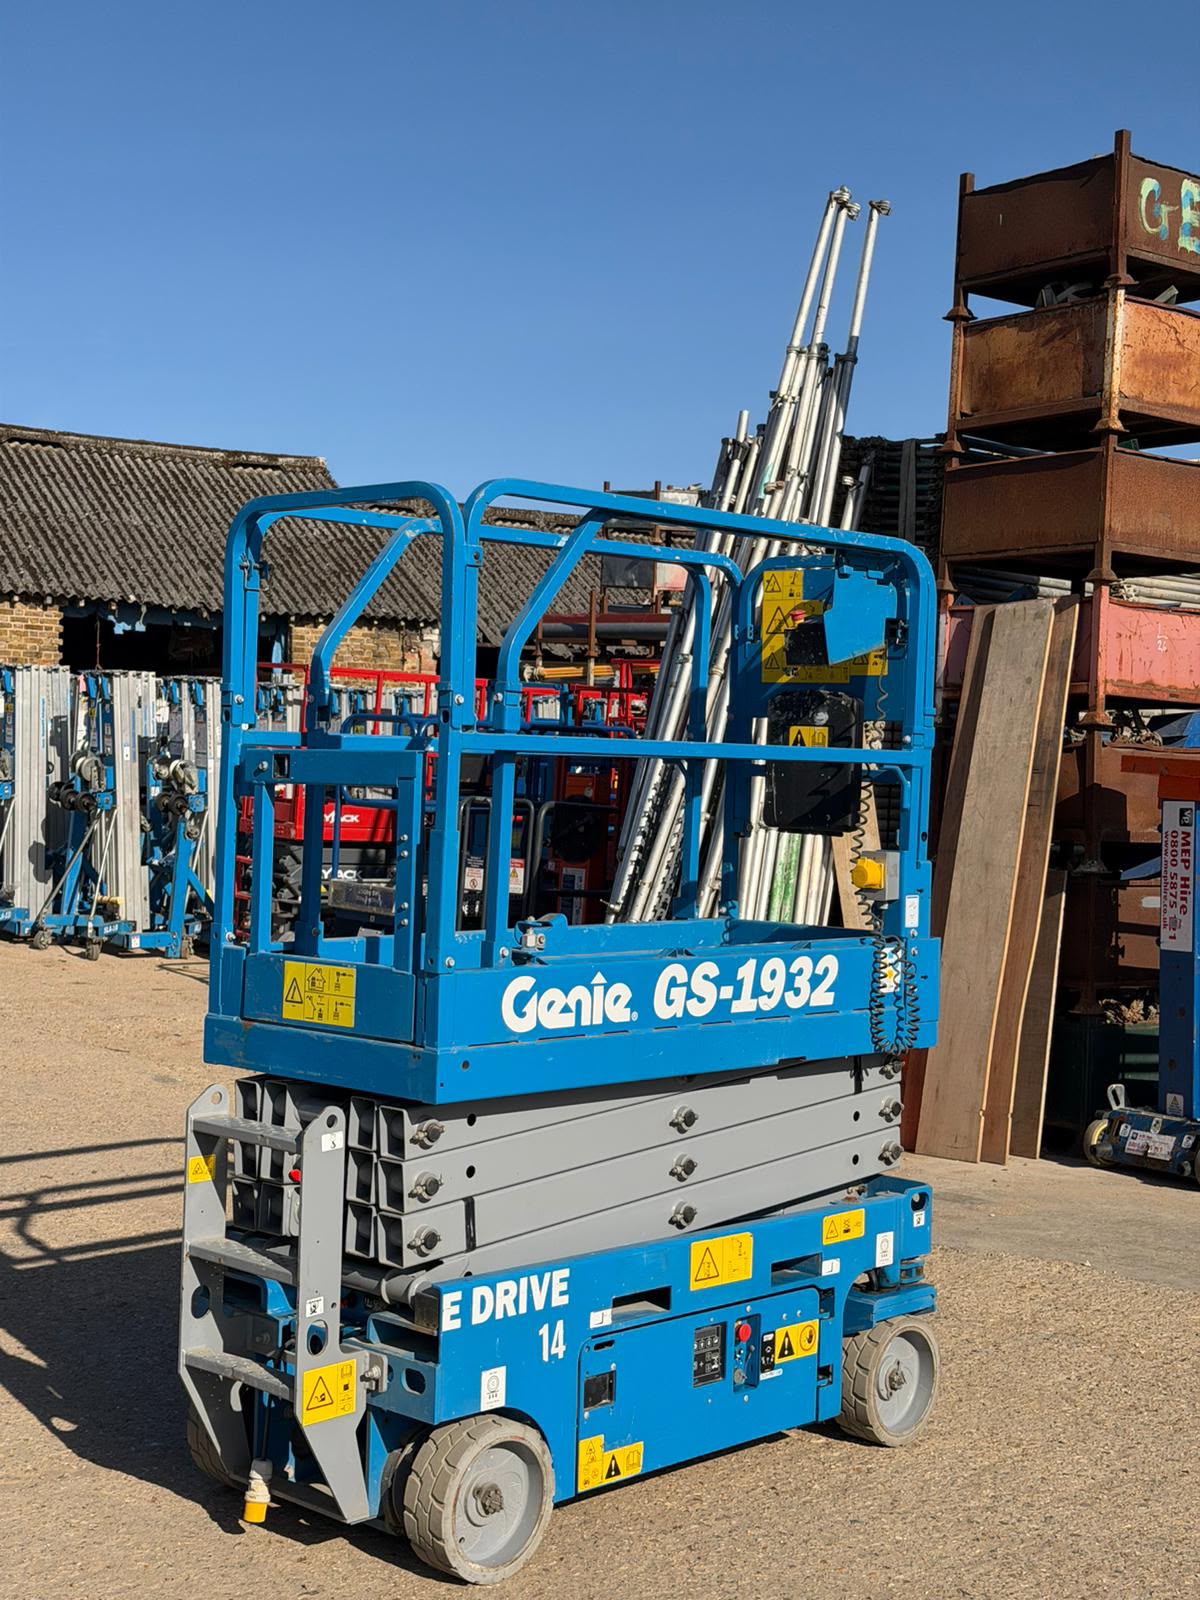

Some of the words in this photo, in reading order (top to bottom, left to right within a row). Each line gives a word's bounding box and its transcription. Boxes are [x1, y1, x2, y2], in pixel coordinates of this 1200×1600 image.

[1170, 830, 1179, 867] 0800
[1181, 831, 1191, 870] MEP
[1169, 872, 1178, 909] 5875
[1180, 876, 1191, 915] Hire
[501, 971, 633, 1033] Genie
[653, 954, 839, 1020] GS-1932
[441, 1290, 463, 1333] E
[471, 1267, 570, 1326] DRIVE
[538, 1319, 567, 1363] 14
